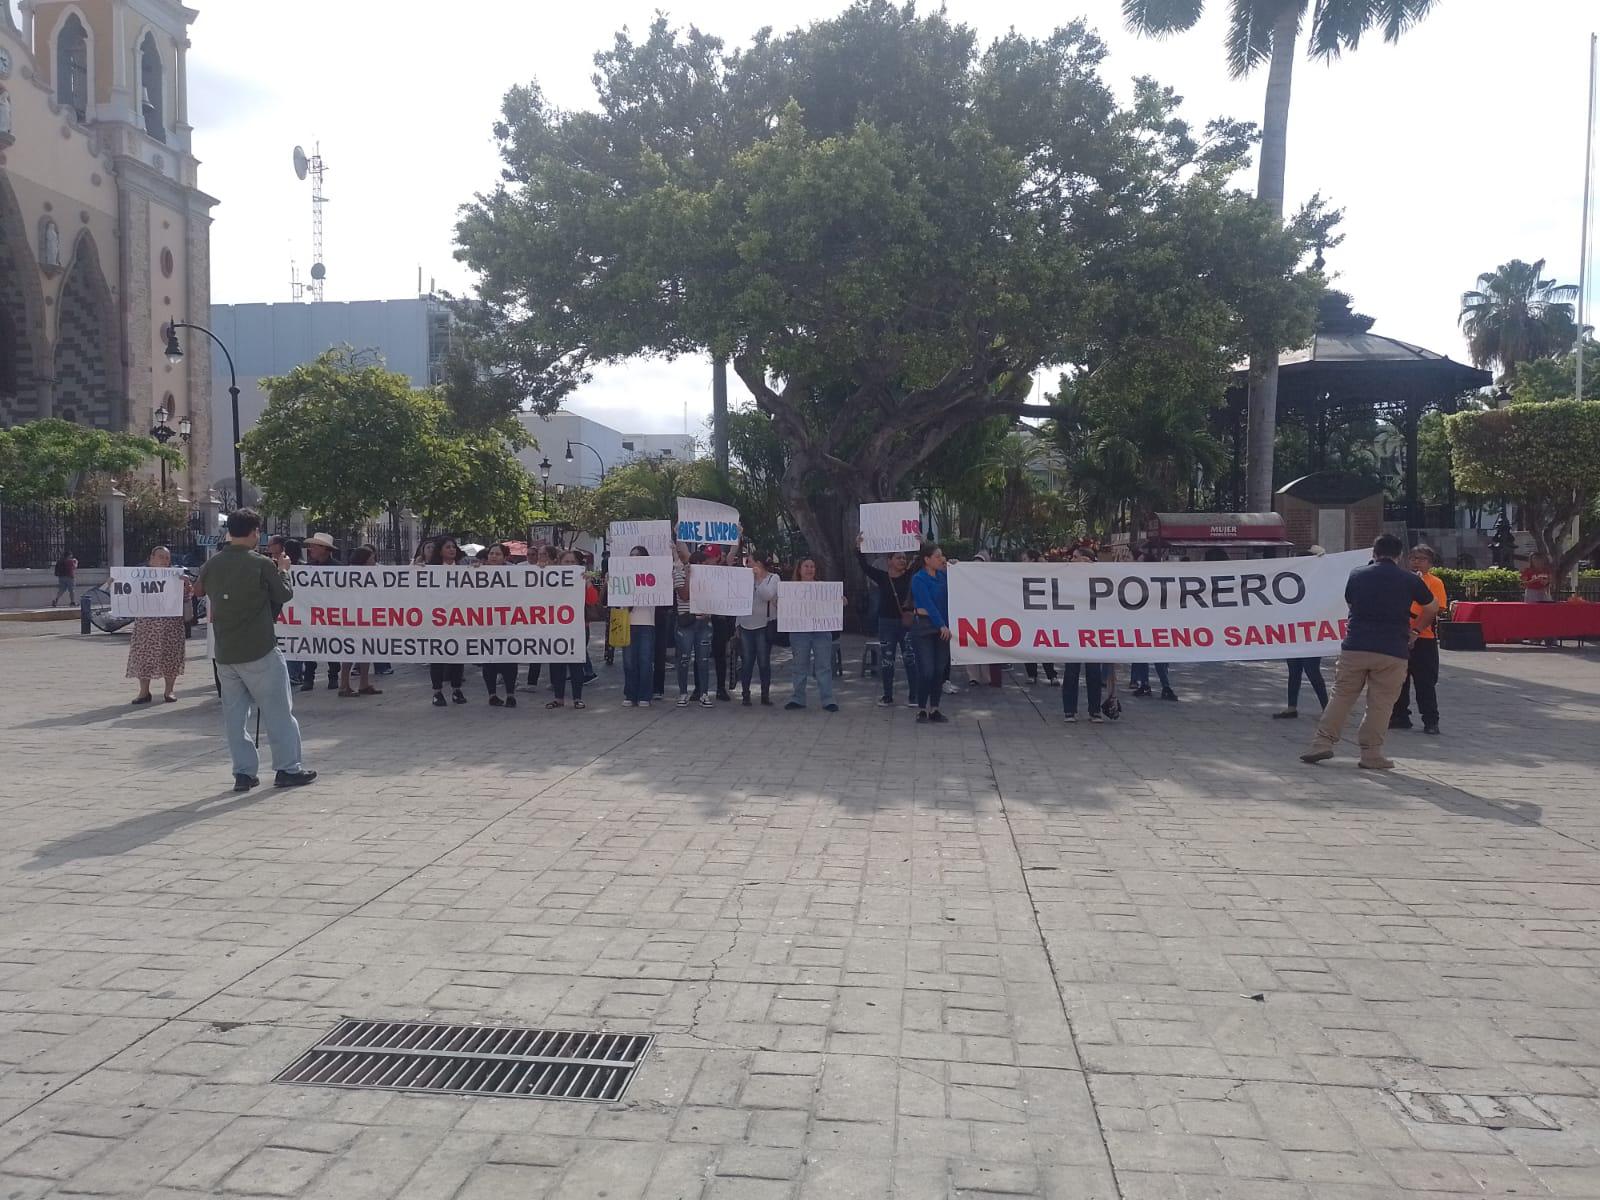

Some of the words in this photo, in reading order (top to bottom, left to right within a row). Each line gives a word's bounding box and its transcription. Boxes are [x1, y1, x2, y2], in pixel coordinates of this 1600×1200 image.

[705, 521, 739, 542] LIMPIO
[902, 520, 920, 535] NO
[1210, 526, 1238, 534] MUJER
[140, 580, 166, 594] HAY
[292, 571, 377, 589] ICATURA
[383, 571, 410, 588] DE
[416, 571, 441, 588] EL
[446, 570, 518, 589] HABAL
[525, 570, 575, 588] DICE
[635, 573, 656, 587] NO
[1022, 577, 1075, 610] EL
[1089, 571, 1306, 610] POTRERO
[310, 607, 423, 627] RELLENO
[431, 605, 575, 627] SANITARIO
[957, 617, 1022, 648] NO
[1033, 629, 1070, 648] AL
[1077, 627, 1214, 649] RELLENO
[276, 636, 355, 655] ETAMOS
[362, 638, 459, 656] NUESTRO
[466, 638, 574, 656] ENTORNO!
